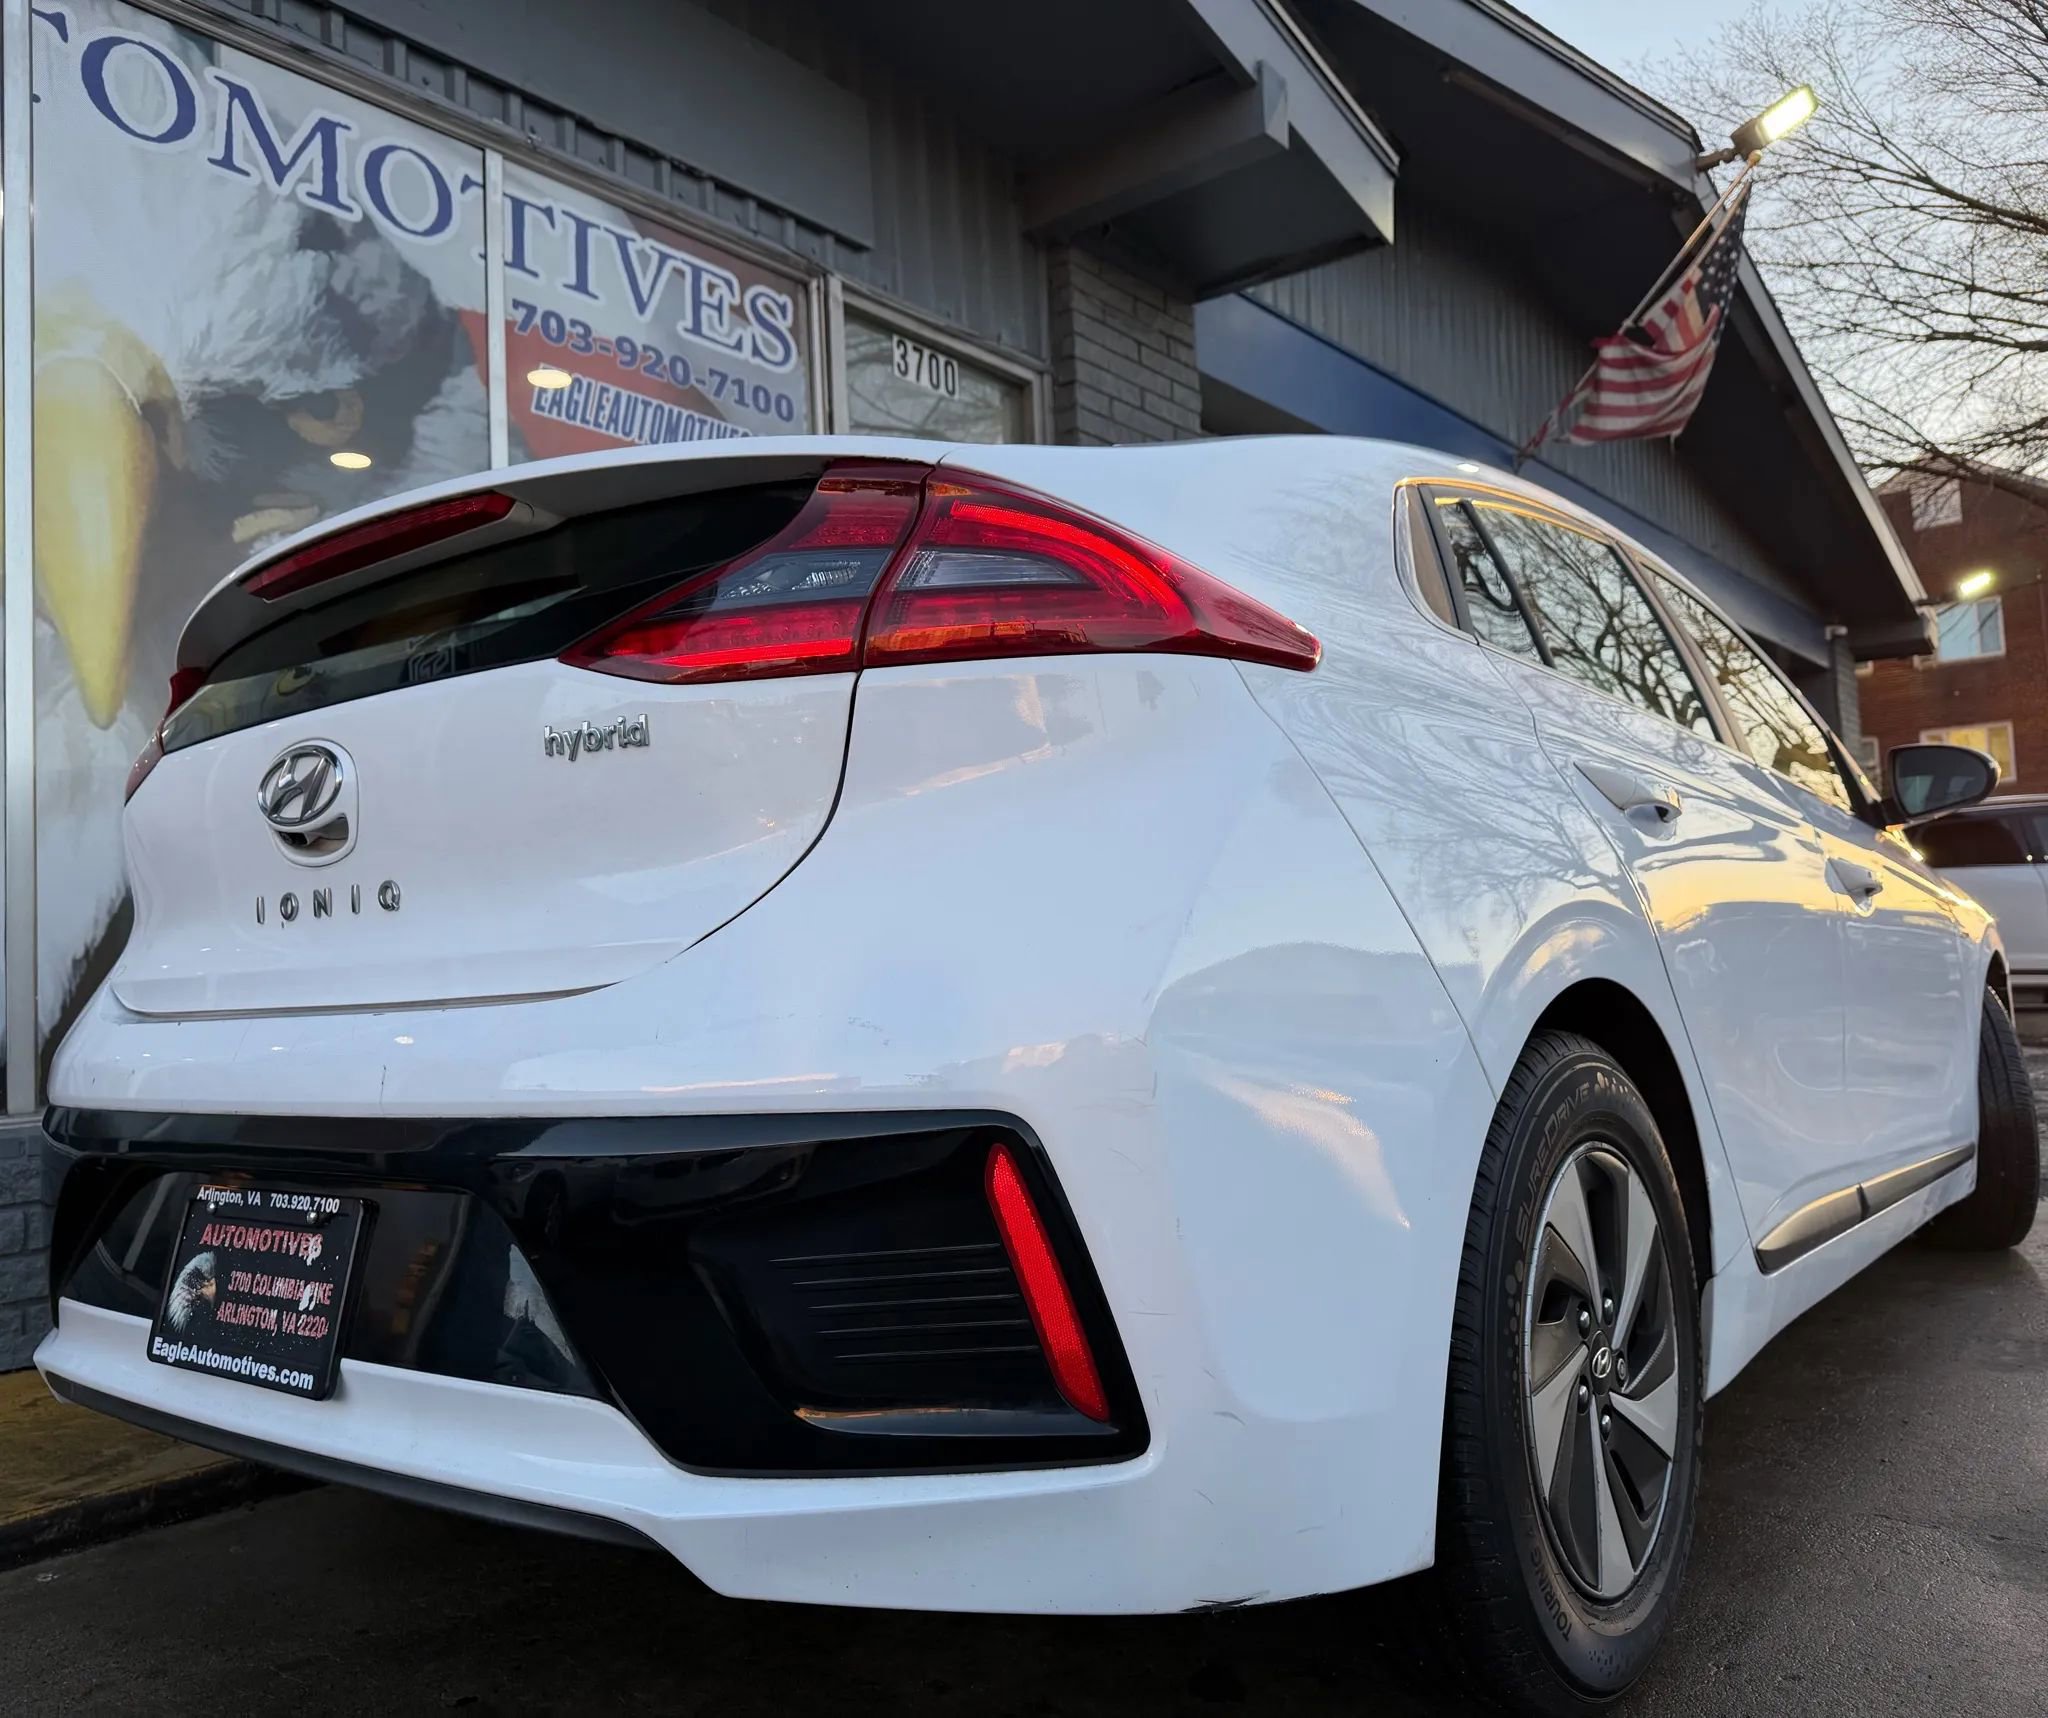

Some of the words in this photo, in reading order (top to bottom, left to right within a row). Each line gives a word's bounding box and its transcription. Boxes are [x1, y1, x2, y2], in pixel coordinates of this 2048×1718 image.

[32, 8, 795, 367] OMOTIVES
[512, 298, 795, 423] 703-920-7100
[896, 339, 957, 396] 3700
[543, 713, 650, 762] hybrid
[255, 879, 402, 925] IONIQ
[197, 1186, 244, 1207] Arlington,
[247, 1190, 261, 1206] VA
[270, 1193, 340, 1214] 703.920.7100
[228, 1270, 253, 1293] 3700
[216, 1301, 278, 1336] ARLINGTON,
[282, 1310, 297, 1334] VA
[151, 1336, 314, 1390] EagleAutomotives.com
[1529, 1546, 1574, 1644] TOURING
